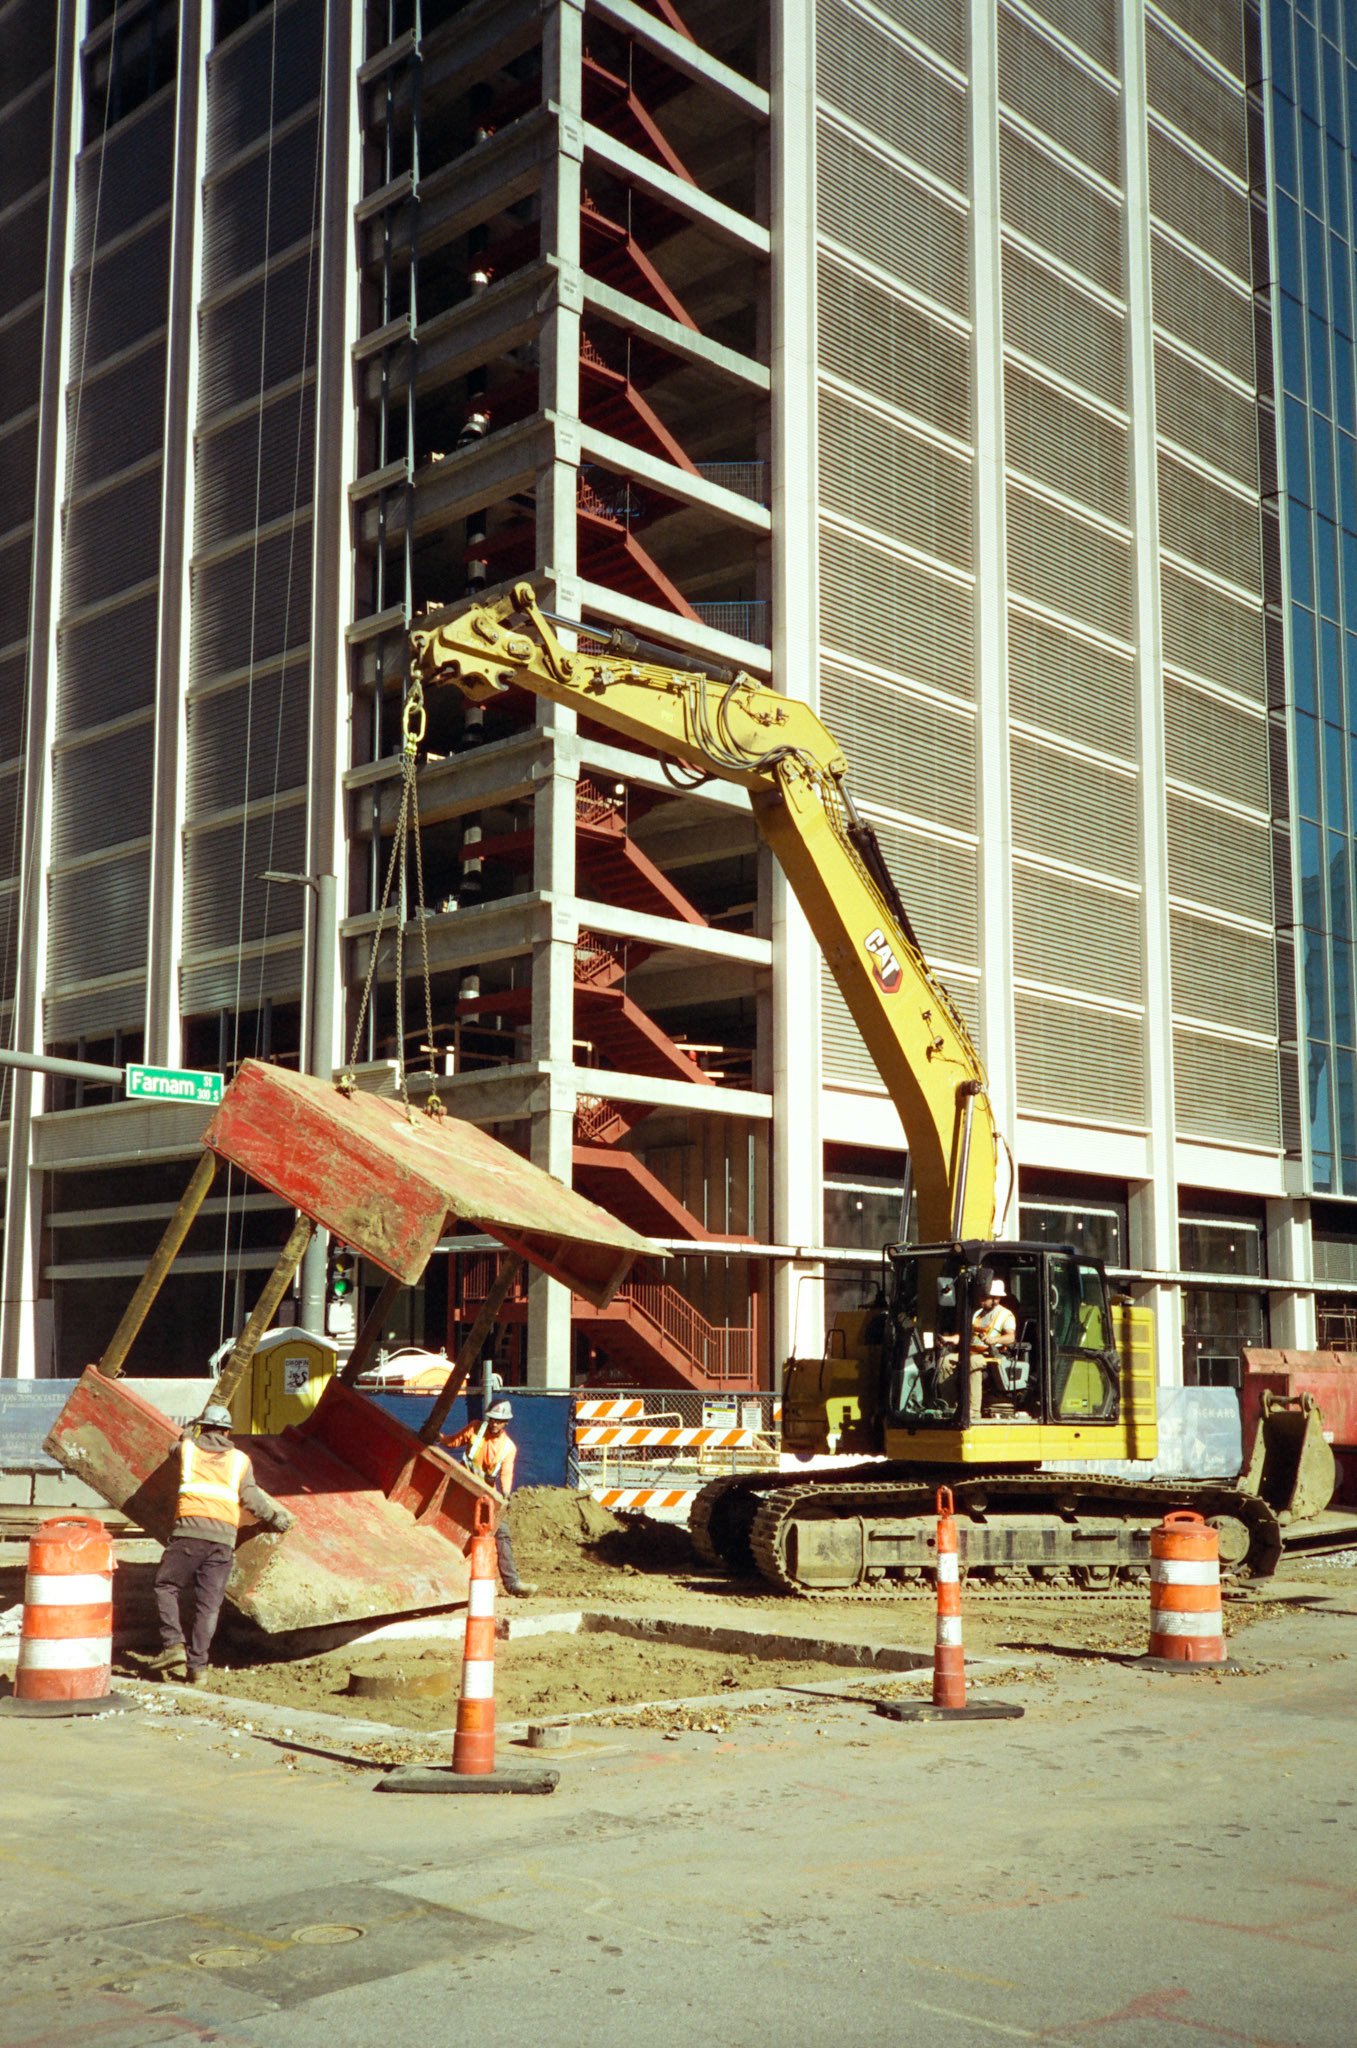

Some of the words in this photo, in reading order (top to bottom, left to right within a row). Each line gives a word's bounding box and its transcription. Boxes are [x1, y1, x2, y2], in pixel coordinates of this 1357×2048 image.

[865, 929, 900, 980] CAT
[132, 1071, 194, 1095] Farnam
[203, 1076, 213, 1087] St
[197, 1088, 210, 1101] 300
[213, 1091, 219, 1101] S
